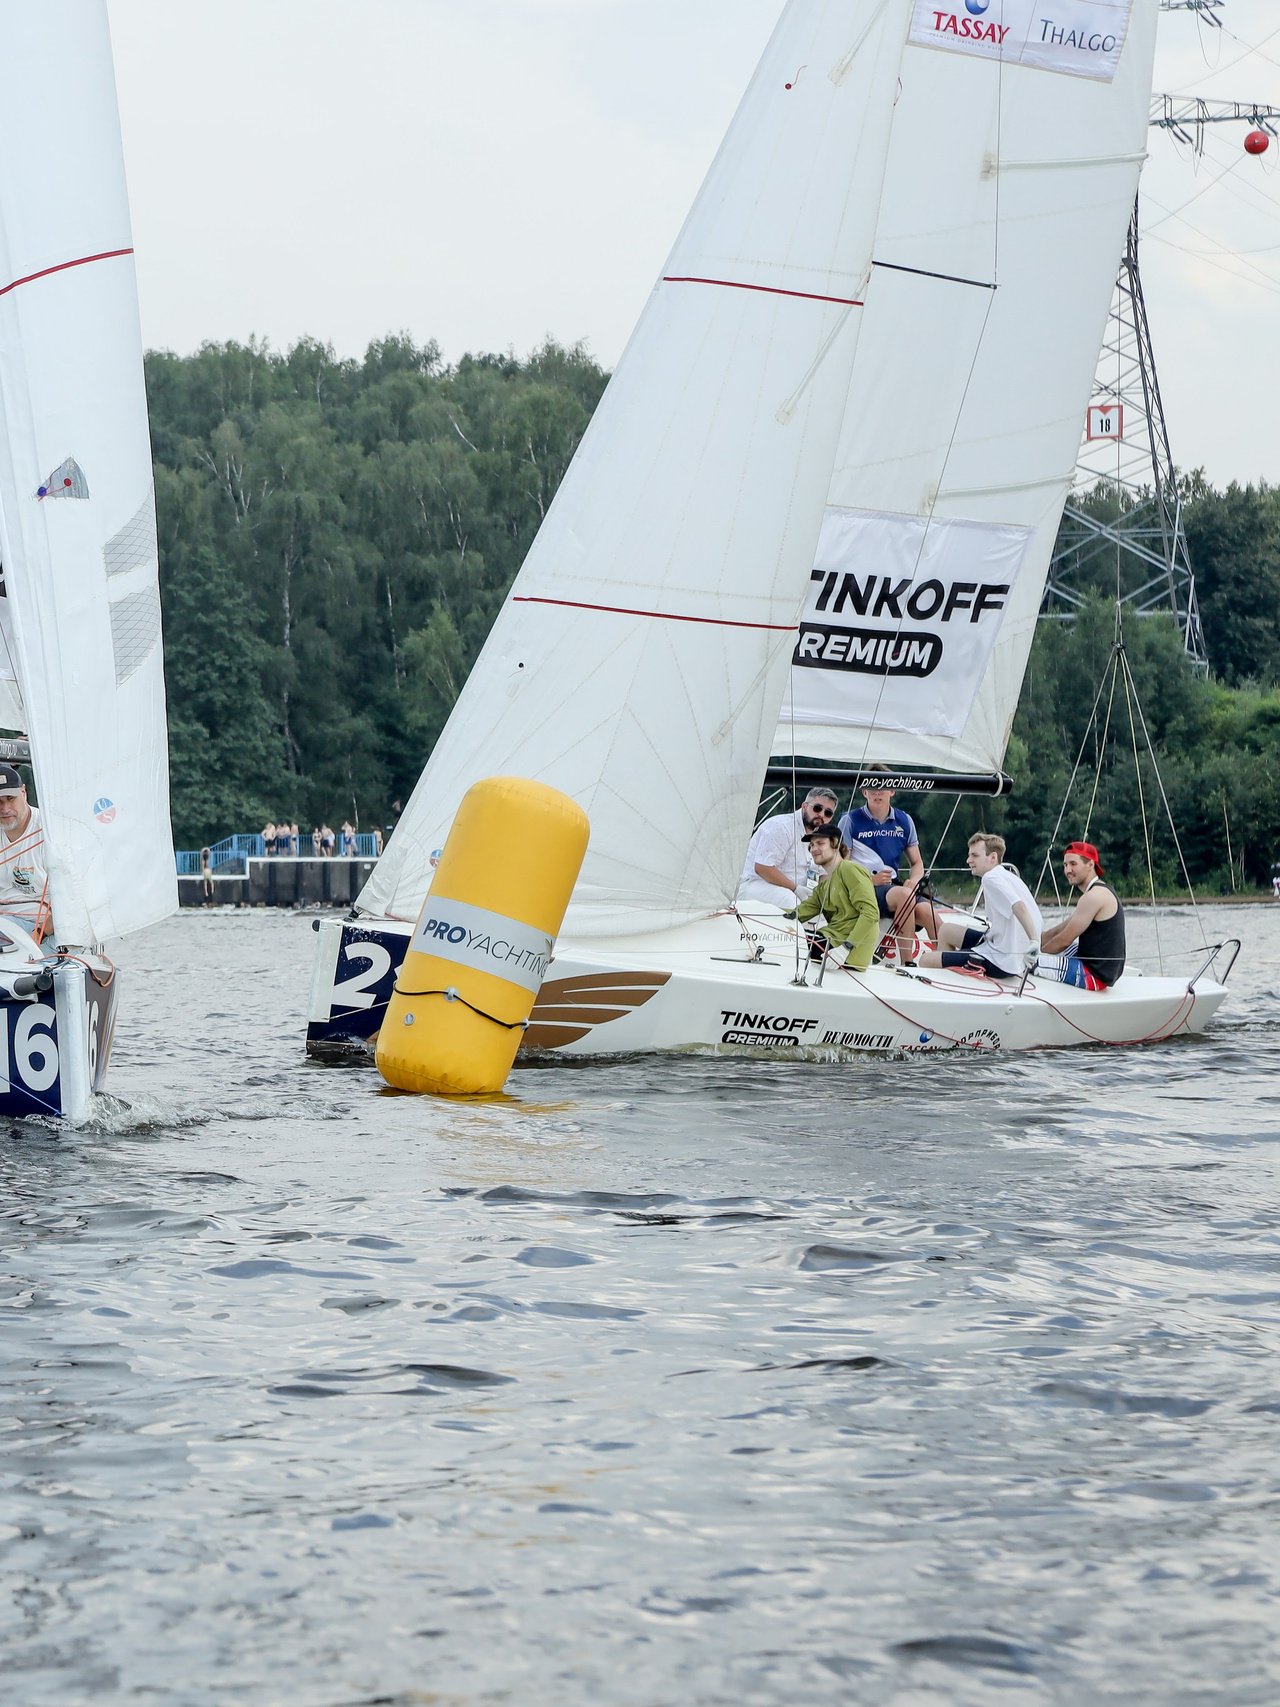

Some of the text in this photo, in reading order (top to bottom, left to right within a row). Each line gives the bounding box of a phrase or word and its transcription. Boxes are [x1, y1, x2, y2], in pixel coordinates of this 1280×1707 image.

[932, 11, 1011, 44] TASSAY
[1040, 19, 1116, 52] THALGO
[1099, 418, 1111, 433] 18
[797, 631, 934, 669] REMIUM
[859, 776, 934, 791] pro-yachting.ru
[857, 829, 905, 839] PROYACHTING
[422, 918, 550, 978] PROYACHTING
[740, 933, 798, 943] PROYACHTING
[329, 941, 404, 1010] 2
[720, 1010, 819, 1033] TINKOFF
[726, 1032, 795, 1046] PREMIUM
